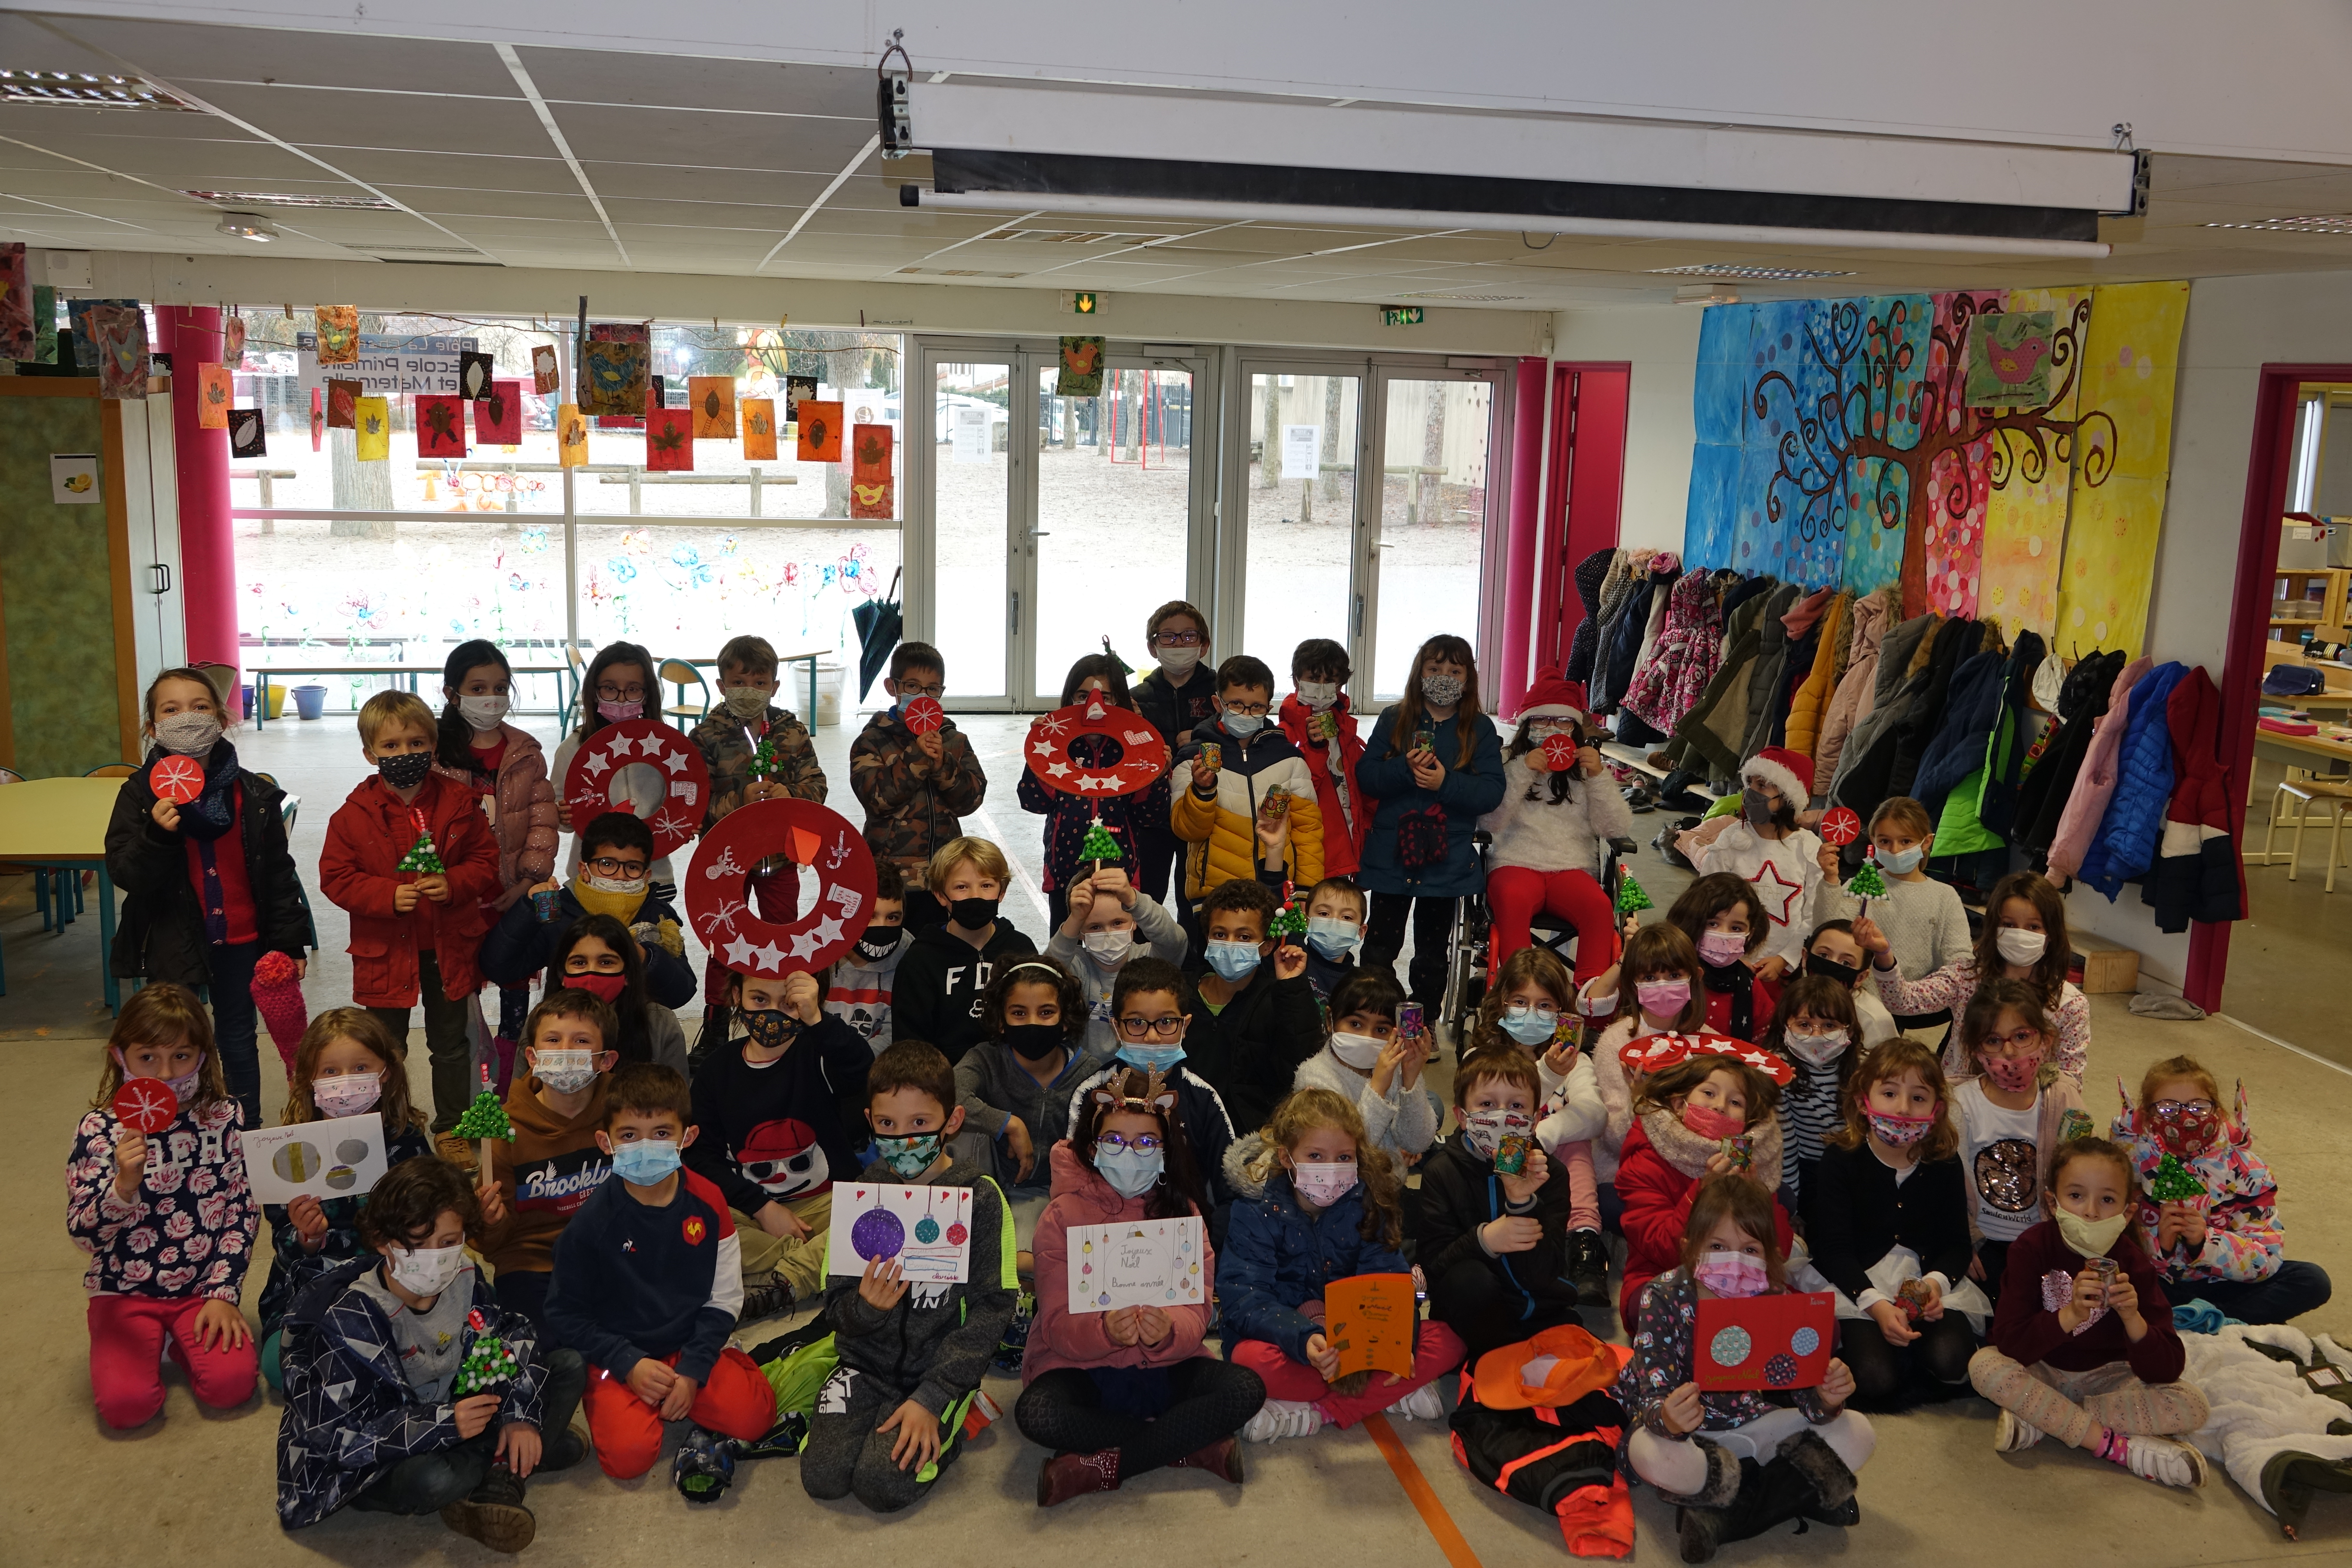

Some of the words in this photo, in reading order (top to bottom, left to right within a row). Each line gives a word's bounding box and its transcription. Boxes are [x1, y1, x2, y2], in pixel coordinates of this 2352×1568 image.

[525, 1158, 612, 1198] Brookly
[557, 1203, 576, 1211] BASEBALL
[1121, 1244, 1152, 1259] Joyeux
[1121, 1256, 1140, 1268] Noël
[1112, 1277, 1136, 1288] Bonne
[1140, 1275, 1164, 1288] année
